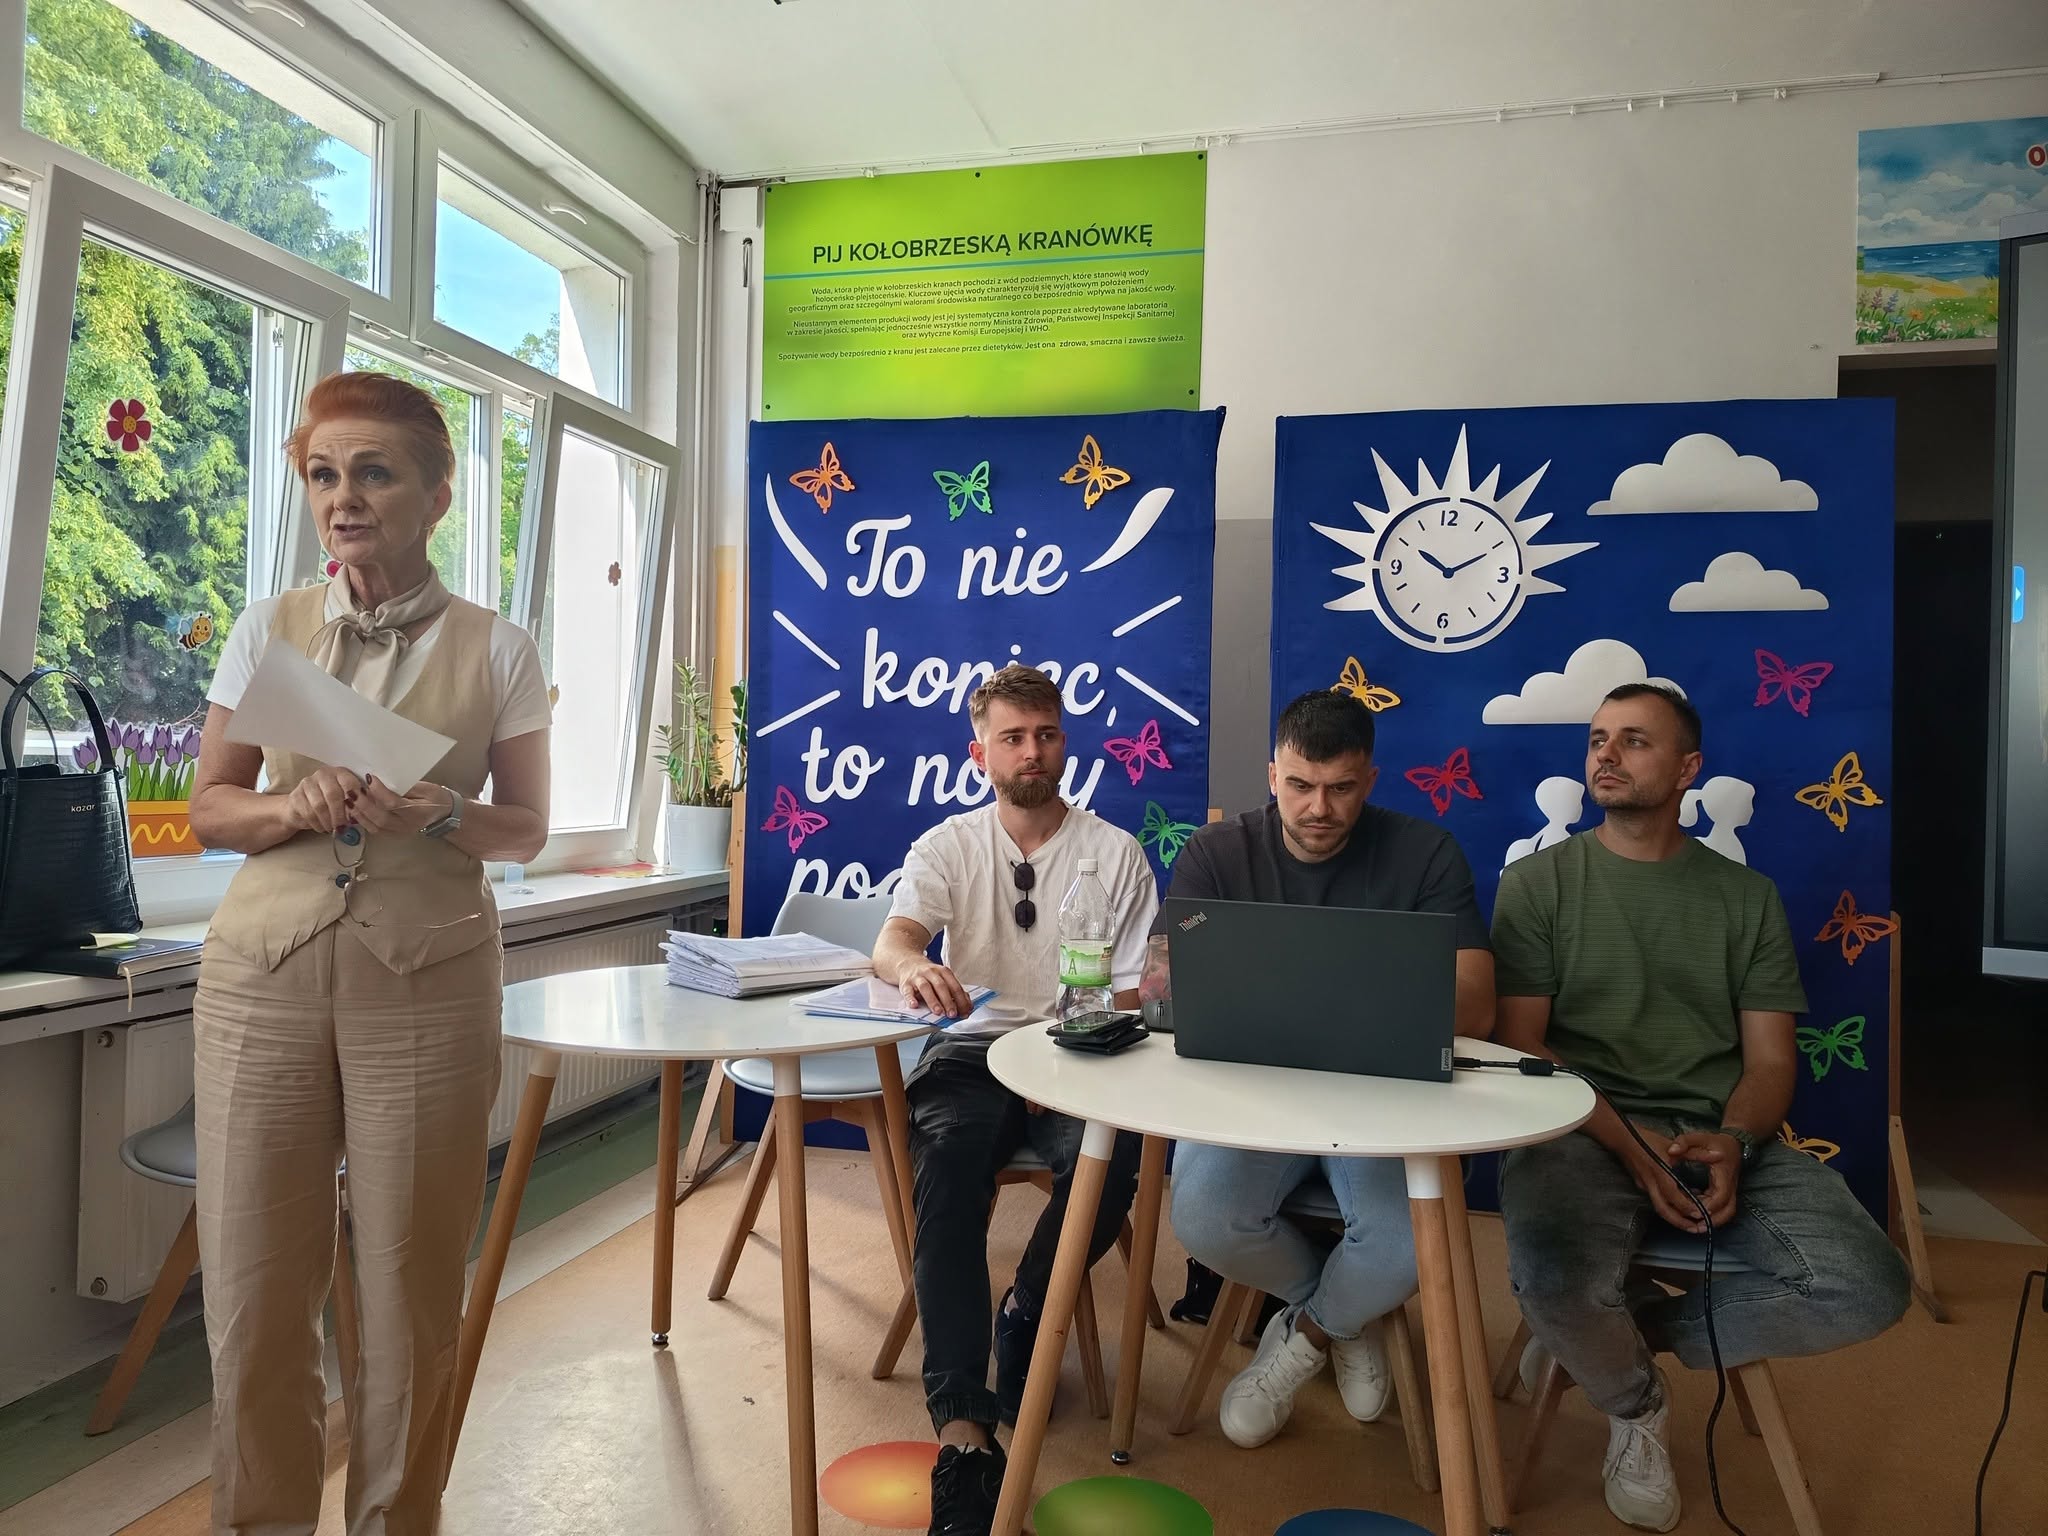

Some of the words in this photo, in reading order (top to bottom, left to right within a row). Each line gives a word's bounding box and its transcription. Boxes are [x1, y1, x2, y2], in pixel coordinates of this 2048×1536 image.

[813, 244, 842, 264] PIJ
[849, 233, 1010, 261] KOŁOBRZESKĄ
[1018, 223, 1152, 251] KRANÓWKĘ
[811, 286, 832, 294] Woda,
[834, 285, 852, 293] która
[853, 284, 874, 294] płynie
[883, 280, 931, 290] kołobrzeskich
[933, 279, 961, 287] kranach
[962, 277, 996, 288] pochodzi
[1002, 276, 1018, 284] wód
[1020, 273, 1071, 284] podziemnych,
[1072, 272, 1091, 280] które
[1093, 270, 1127, 279] stanowią
[1128, 269, 1149, 278] wody
[815, 290, 905, 302] holoceńsko-plejstoceńskie.
[908, 289, 941, 297] Kluczowe
[943, 286, 964, 296] ujęcia
[965, 285, 984, 294] wody
[986, 282, 1039, 292] charakteryzują
[1040, 282, 1051, 291] się
[1053, 280, 1098, 290] wyjątkowym
[1100, 277, 1144, 288] położeniem
[788, 302, 838, 312] geograficznym
[855, 298, 902, 308] szczególnymi
[903, 296, 935, 305] walorami
[936, 294, 976, 303] środowiska
[978, 292, 1021, 301] naturalnego
[1033, 288, 1083, 299] bezpośrednio
[1086, 287, 1116, 297] wpływa
[1127, 285, 1153, 295] jakość
[1154, 284, 1176, 293] wody.
[793, 319, 837, 328] Nieustannym
[838, 316, 877, 325] elementem
[878, 314, 910, 325] produkcji
[911, 313, 931, 322] wody
[932, 312, 945, 322] jest
[946, 312, 955, 321] jej
[956, 310, 1009, 320] systematyczna
[1010, 307, 1041, 316] kontrola
[1042, 307, 1071, 316] poprzez
[1072, 303, 1125, 313] akredytowane
[1127, 300, 1168, 309] laboratoria
[794, 327, 822, 335] zakresie
[822, 325, 849, 336] jakości,
[850, 324, 885, 334] spełniając
[885, 321, 931, 332] jednocześnie
[933, 320, 968, 329] wszystkie
[993, 317, 1022, 325] Ministra
[1023, 315, 1055, 324] Zdrowia,
[1056, 313, 1100, 322] Państwowej
[1102, 311, 1135, 321] Inspekcji
[1136, 309, 1175, 318] Sanitarnej
[918, 329, 951, 339] wytyczne
[952, 327, 978, 336] Komisji
[979, 325, 1024, 335] Europejskiej
[1029, 324, 1050, 332] WHO.
[778, 350, 818, 361] Spożywanie
[819, 349, 838, 358] wody
[839, 347, 886, 358] bezpośrednio
[893, 346, 913, 354] kranu
[914, 345, 927, 355] jest
[961, 345, 980, 353] przez
[982, 341, 1024, 351] dietetyków.
[1024, 340, 1040, 348] Jest
[1157, 334, 1185, 342] świeża.
[1440, 510, 1459, 527] 12
[846, 514, 926, 598] To
[957, 527, 1069, 600] nie
[1391, 559, 1402, 575] 9
[1497, 567, 1509, 583] 3
[1437, 613, 1448, 629] 6
[863, 627, 1117, 727] konc,
[801, 726, 885, 804] to
[908, 753, 1105, 816] noy
[71, 804, 96, 812] kazar
[1178, 911, 1207, 931] ThinkPad
